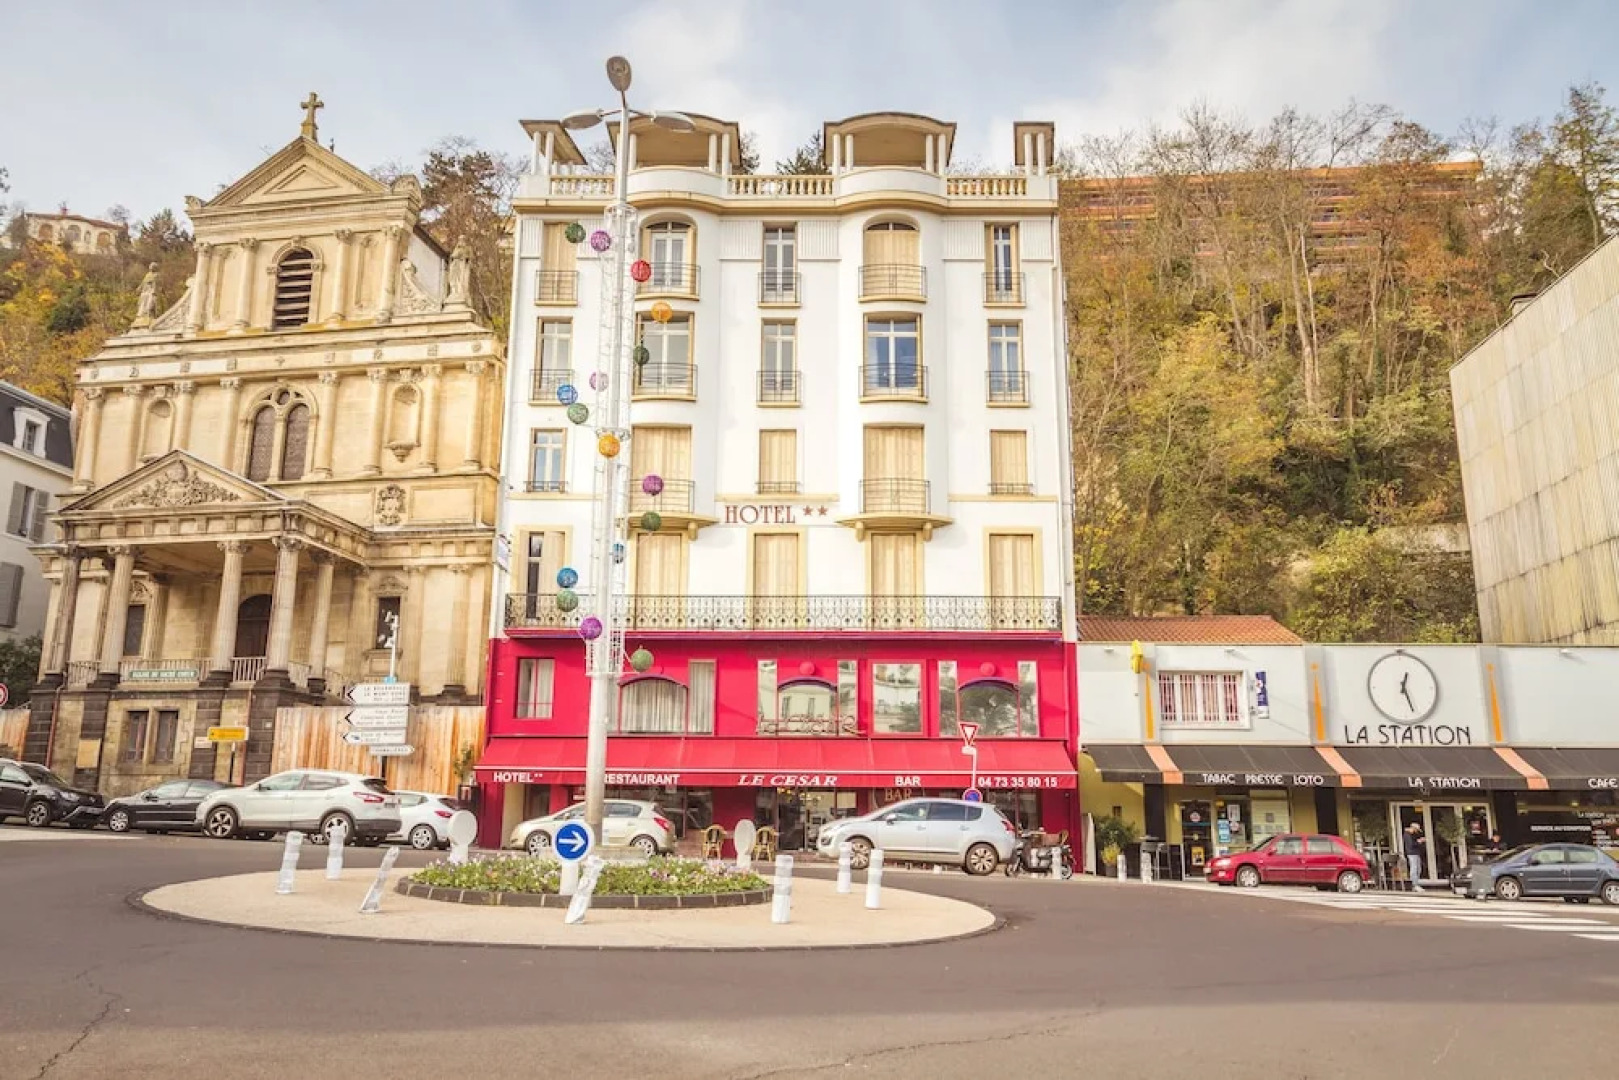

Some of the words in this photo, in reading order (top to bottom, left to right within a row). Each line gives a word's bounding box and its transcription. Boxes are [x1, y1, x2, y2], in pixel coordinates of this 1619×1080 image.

[725, 505, 796, 523] HOTEL
[1344, 725, 1369, 744] LA
[1378, 725, 1472, 746] STATION
[493, 771, 534, 783] HOTEL
[738, 775, 765, 786] LE
[770, 775, 838, 786] CESAR
[895, 775, 922, 787] BAR
[978, 776, 992, 787] 04
[994, 776, 1008, 787] 73
[1011, 776, 1025, 787] 35
[1027, 776, 1042, 787] 80
[1044, 776, 1058, 788] 15
[1202, 773, 1236, 784] TABAC
[1245, 773, 1283, 785] PRESSE
[1293, 775, 1324, 786] LOTO
[1408, 776, 1424, 788] LA
[1429, 776, 1481, 788] STATION
